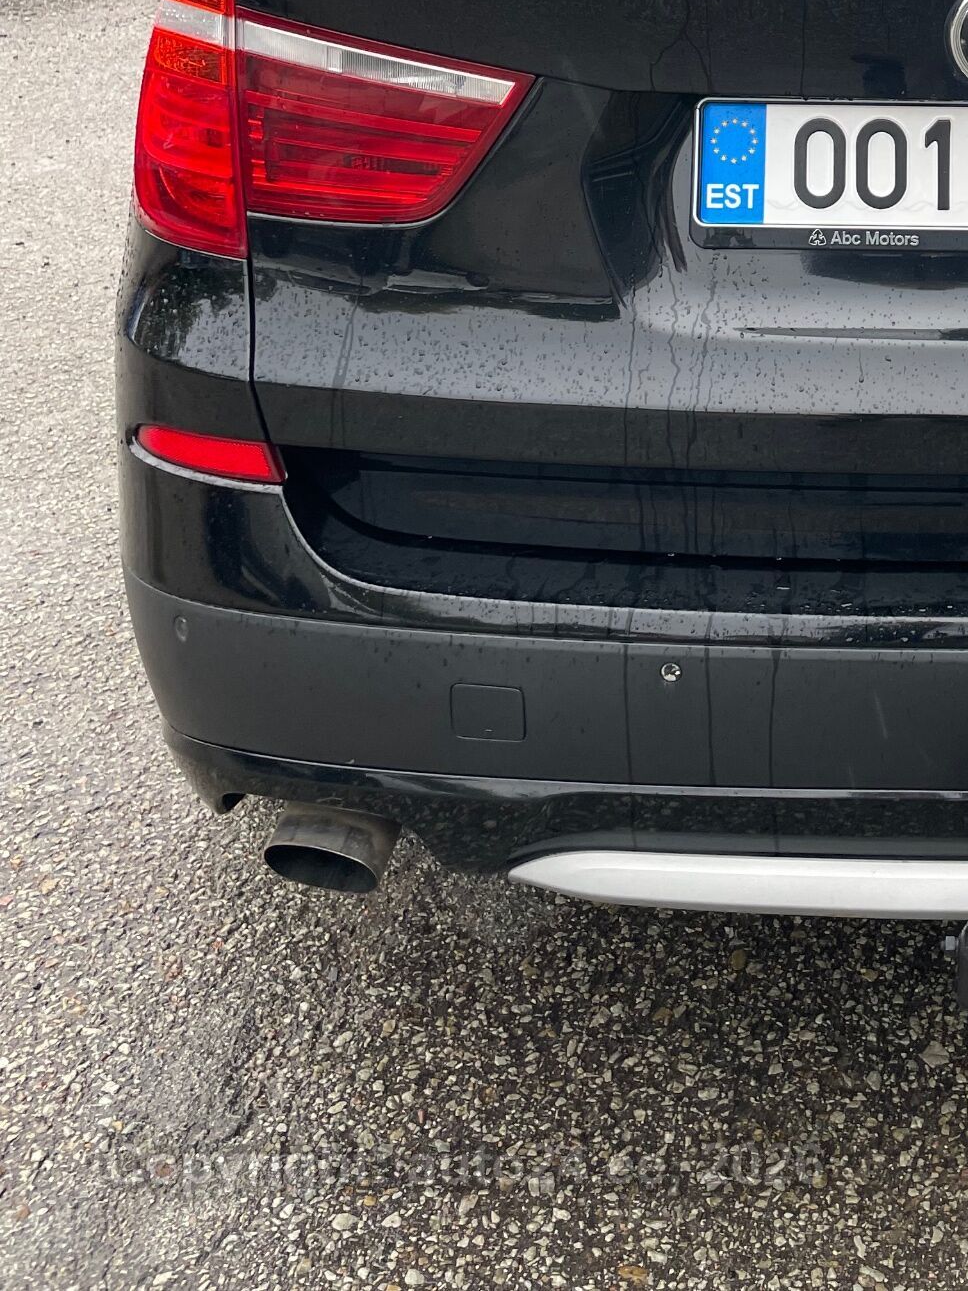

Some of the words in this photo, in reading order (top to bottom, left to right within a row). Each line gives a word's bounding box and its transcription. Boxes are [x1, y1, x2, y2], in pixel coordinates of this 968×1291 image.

[793, 118, 951, 210] 001
[706, 182, 759, 210] EST
[830, 230, 861, 245] Abc
[866, 231, 919, 246] Motors
